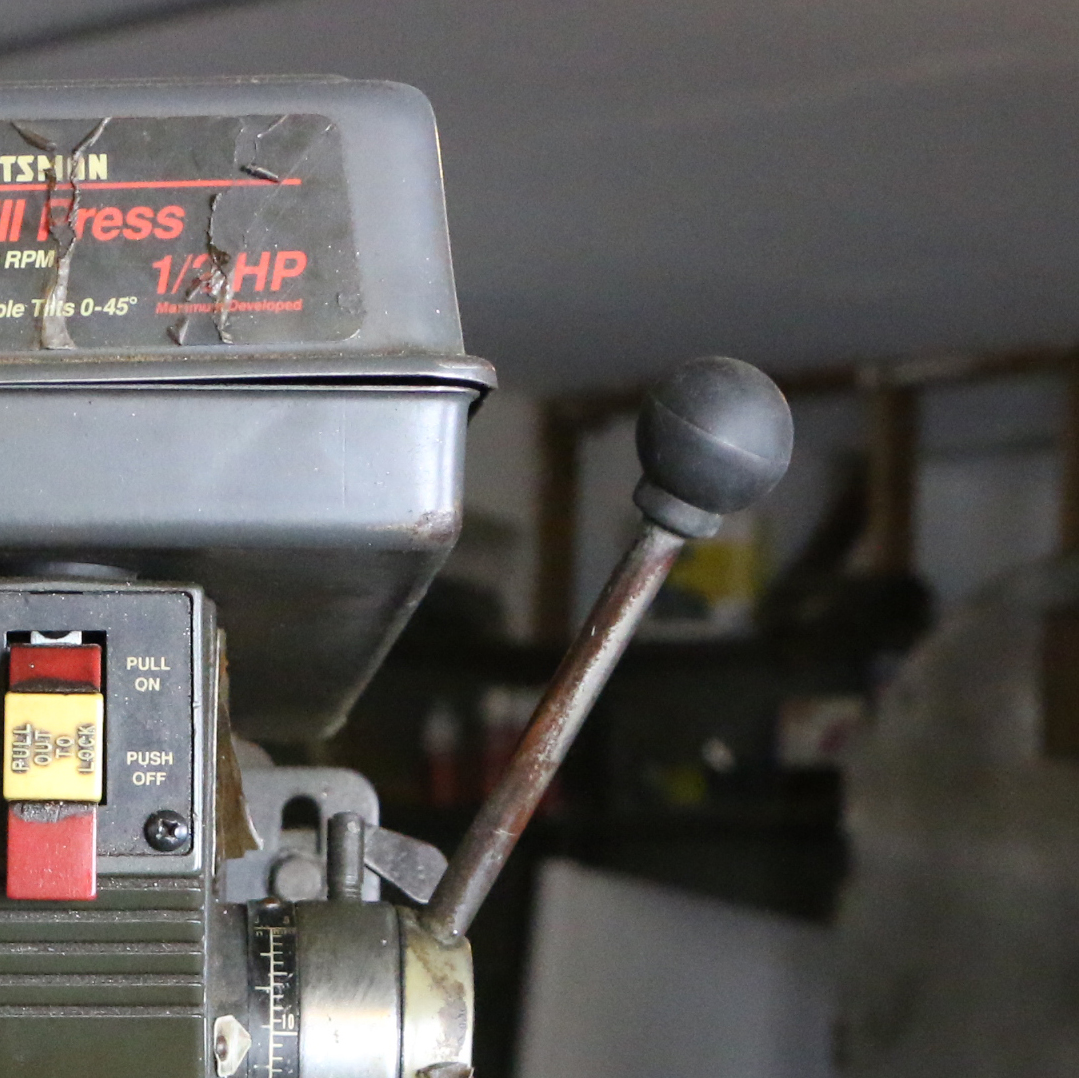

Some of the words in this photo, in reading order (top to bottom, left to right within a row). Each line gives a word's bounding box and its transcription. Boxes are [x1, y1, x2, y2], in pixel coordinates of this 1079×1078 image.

[37, 199, 186, 242] Press
[5, 250, 56, 270] RPM
[232, 250, 308, 292] HP
[80, 296, 139, 317] 0-45°
[156, 302, 224, 315] Maimu
[228, 299, 303, 315] Developed
[126, 656, 171, 671] PULL
[134, 677, 161, 691] ON
[11, 723, 32, 774] PULL
[34, 730, 52, 767] OUT
[55, 735, 74, 759] TO
[77, 724, 96, 775] LOCK
[126, 751, 174, 765] PUSH
[132, 771, 167, 786] OFF
[281, 1014, 295, 1030] 10
